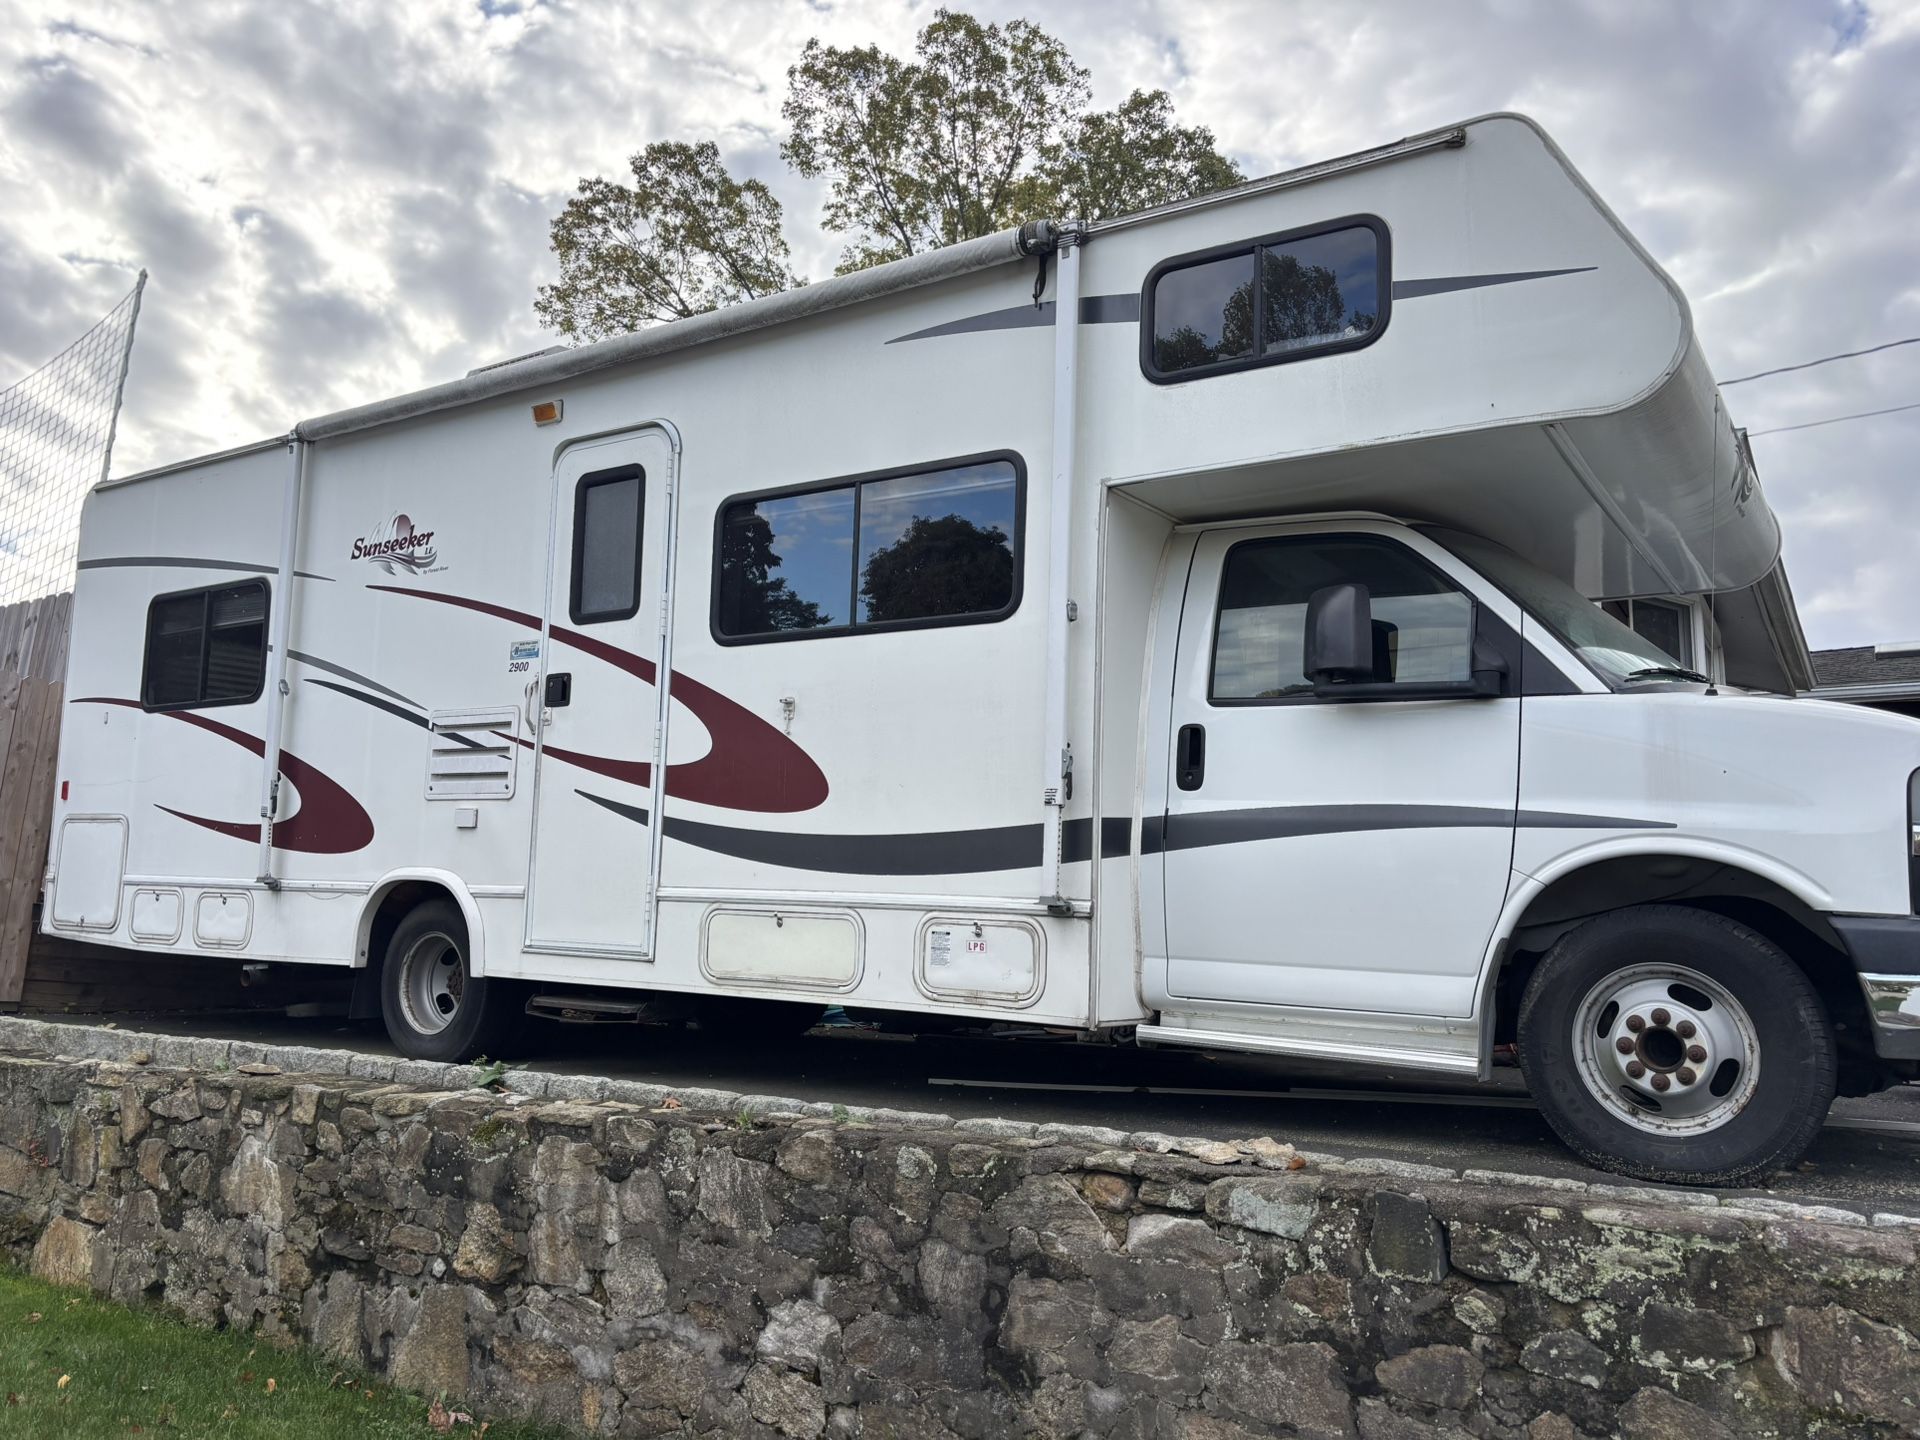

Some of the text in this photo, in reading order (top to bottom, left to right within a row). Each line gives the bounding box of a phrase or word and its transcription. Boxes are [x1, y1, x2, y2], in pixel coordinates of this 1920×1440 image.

[350, 525, 434, 560] Sunseeker
[508, 661, 530, 673] 2900
[968, 942, 985, 952] LPG
